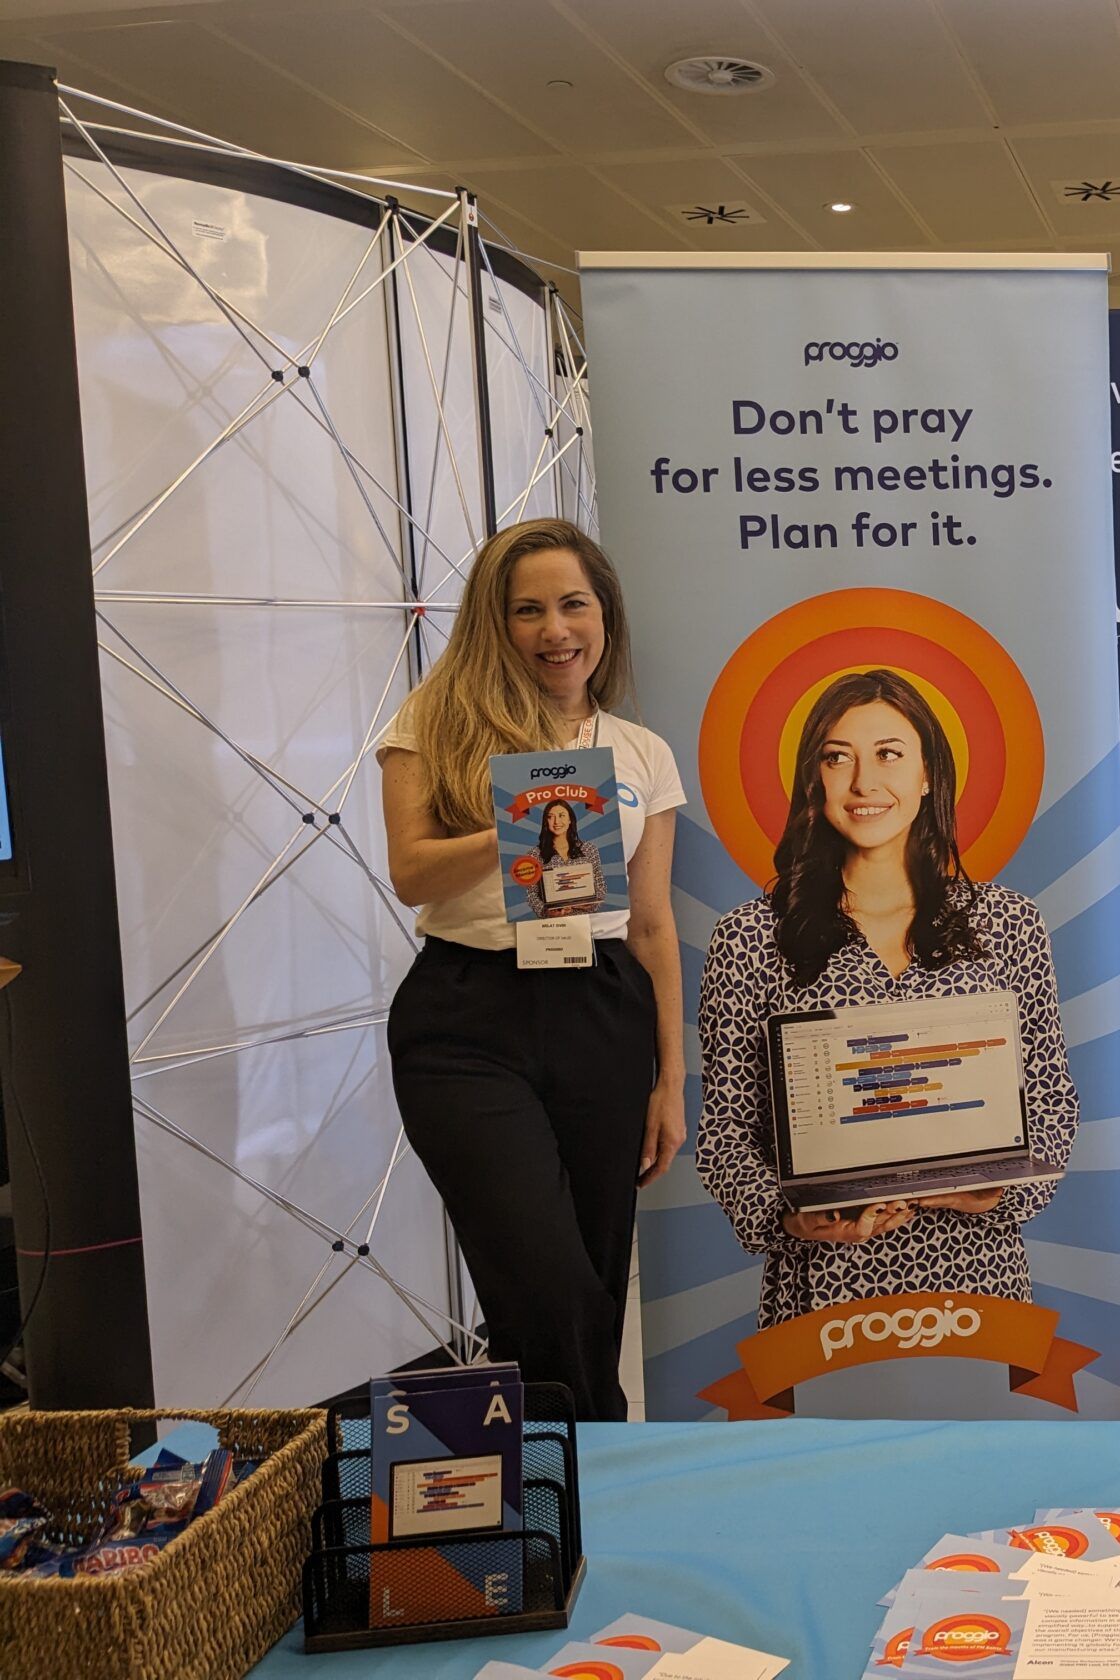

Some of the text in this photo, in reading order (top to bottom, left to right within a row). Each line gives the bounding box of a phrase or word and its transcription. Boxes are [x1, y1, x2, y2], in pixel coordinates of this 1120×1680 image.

[804, 338, 898, 368] proggio
[731, 398, 974, 443] Don't pray
[650, 454, 1053, 498] for less meetings.
[739, 511, 977, 549] Plan for it.
[530, 763, 577, 780] proggio
[526, 785, 588, 804] Pro Club
[819, 1300, 980, 1360] proggio
[386, 1394, 512, 1434] S A
[933, 1630, 1000, 1643] proggio
